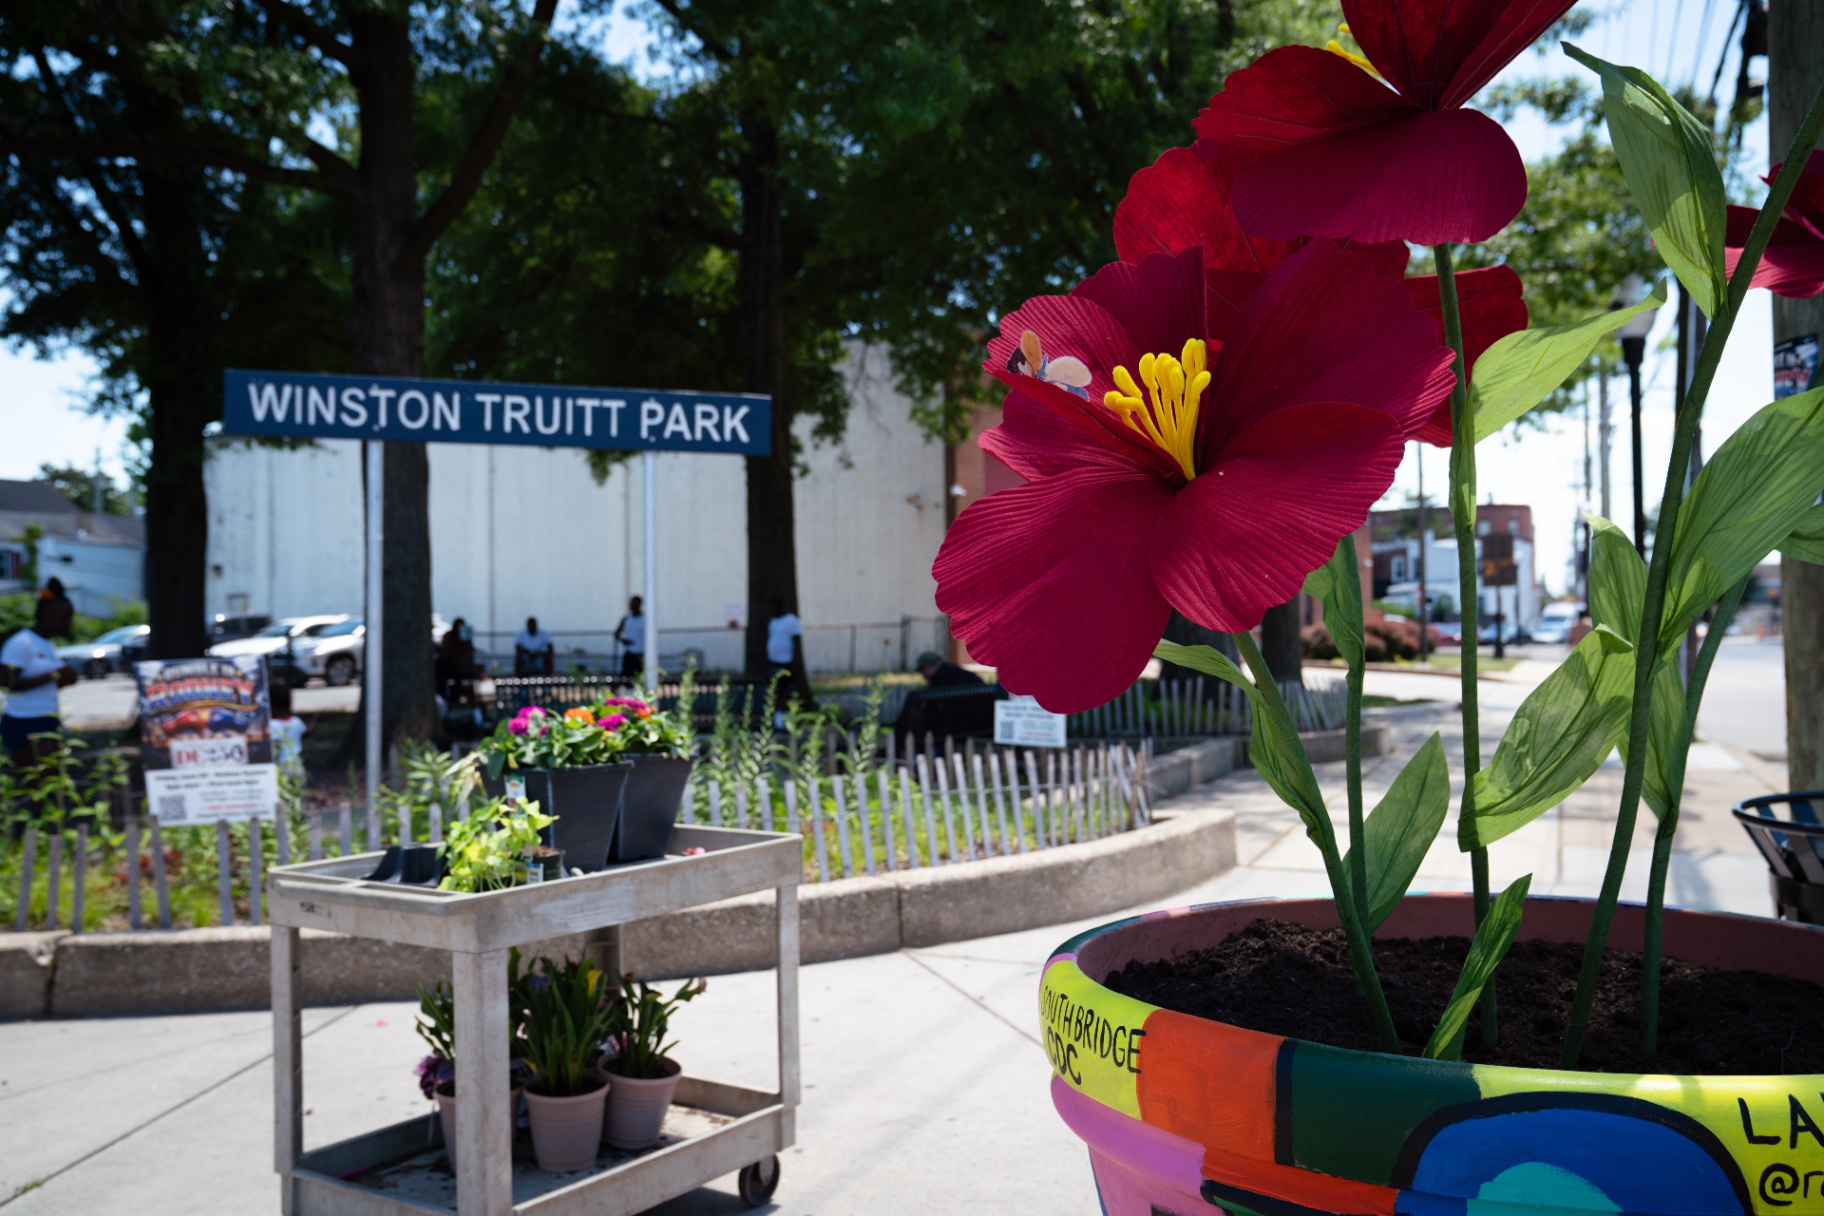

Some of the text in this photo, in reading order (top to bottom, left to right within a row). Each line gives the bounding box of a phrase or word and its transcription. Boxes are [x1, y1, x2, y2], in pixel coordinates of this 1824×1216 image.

[249, 384, 750, 443] WINSTON TRUITT PARK
[1041, 985, 1147, 1073] SOUTHBRIDGE
[1047, 1026, 1082, 1085] CDC
[1737, 1091, 1824, 1150] LA
[1759, 1163, 1824, 1206] @r
